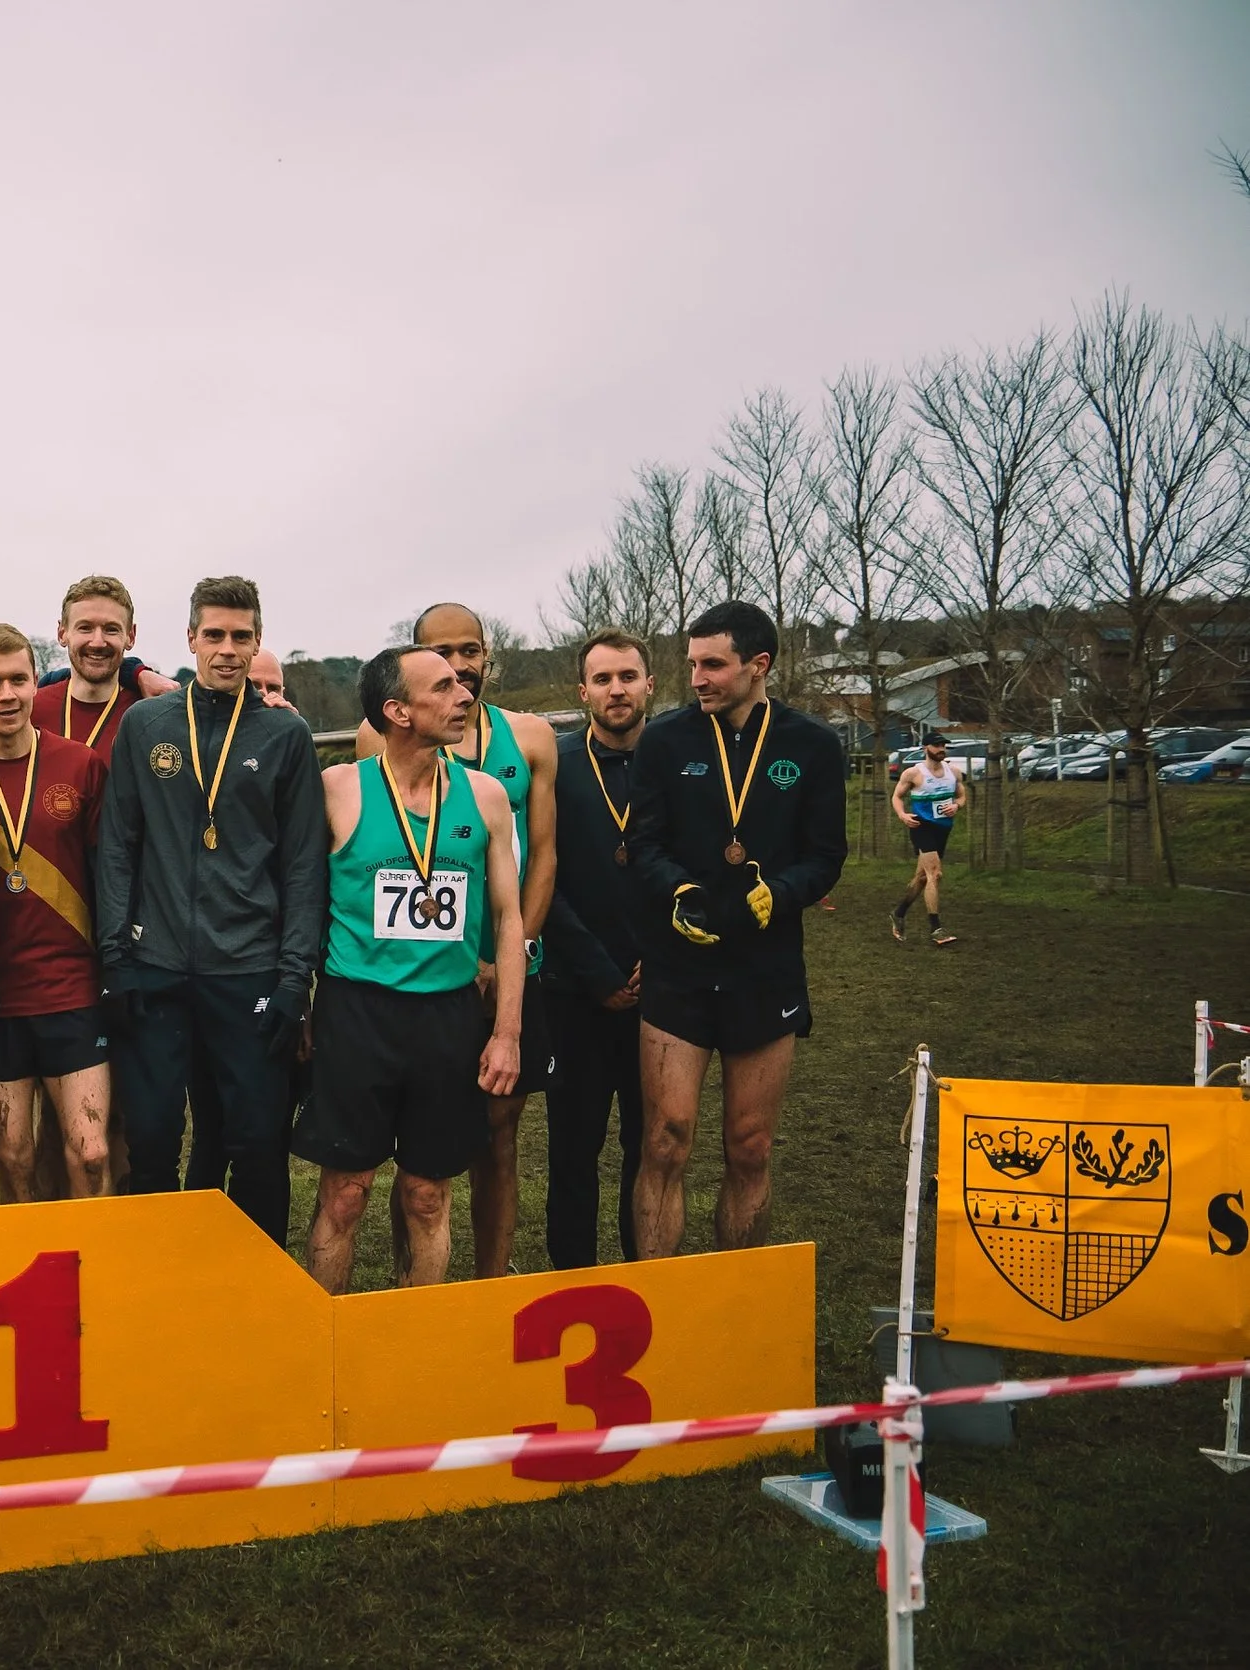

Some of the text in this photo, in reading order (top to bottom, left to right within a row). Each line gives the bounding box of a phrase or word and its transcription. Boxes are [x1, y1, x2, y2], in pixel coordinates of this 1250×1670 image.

[365, 855, 410, 872] GUILDFOR
[379, 872, 412, 881] SURREY
[414, 874, 449, 882] CNTY
[382, 886, 457, 931] 768
[1208, 1189, 1249, 1256] S
[512, 1284, 653, 1483] 3
